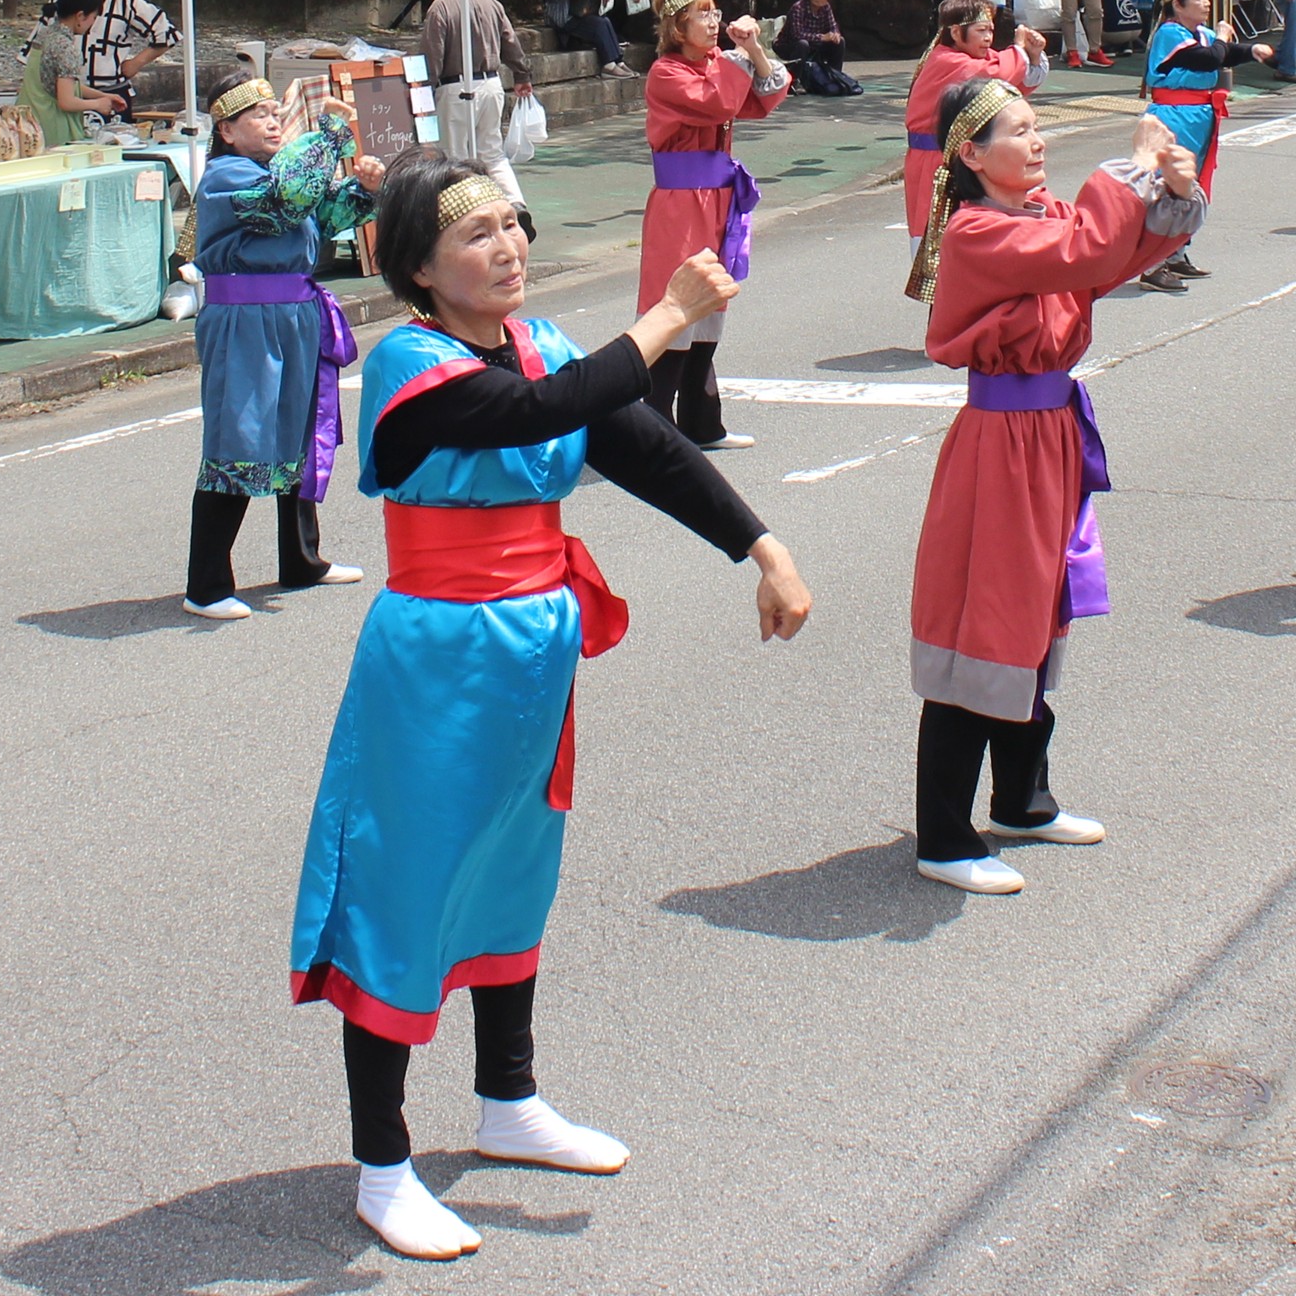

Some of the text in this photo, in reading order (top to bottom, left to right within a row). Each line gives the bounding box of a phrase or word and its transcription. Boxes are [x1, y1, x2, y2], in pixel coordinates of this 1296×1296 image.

[372, 104, 391, 114] トタン
[366, 121, 416, 152] to tongue
